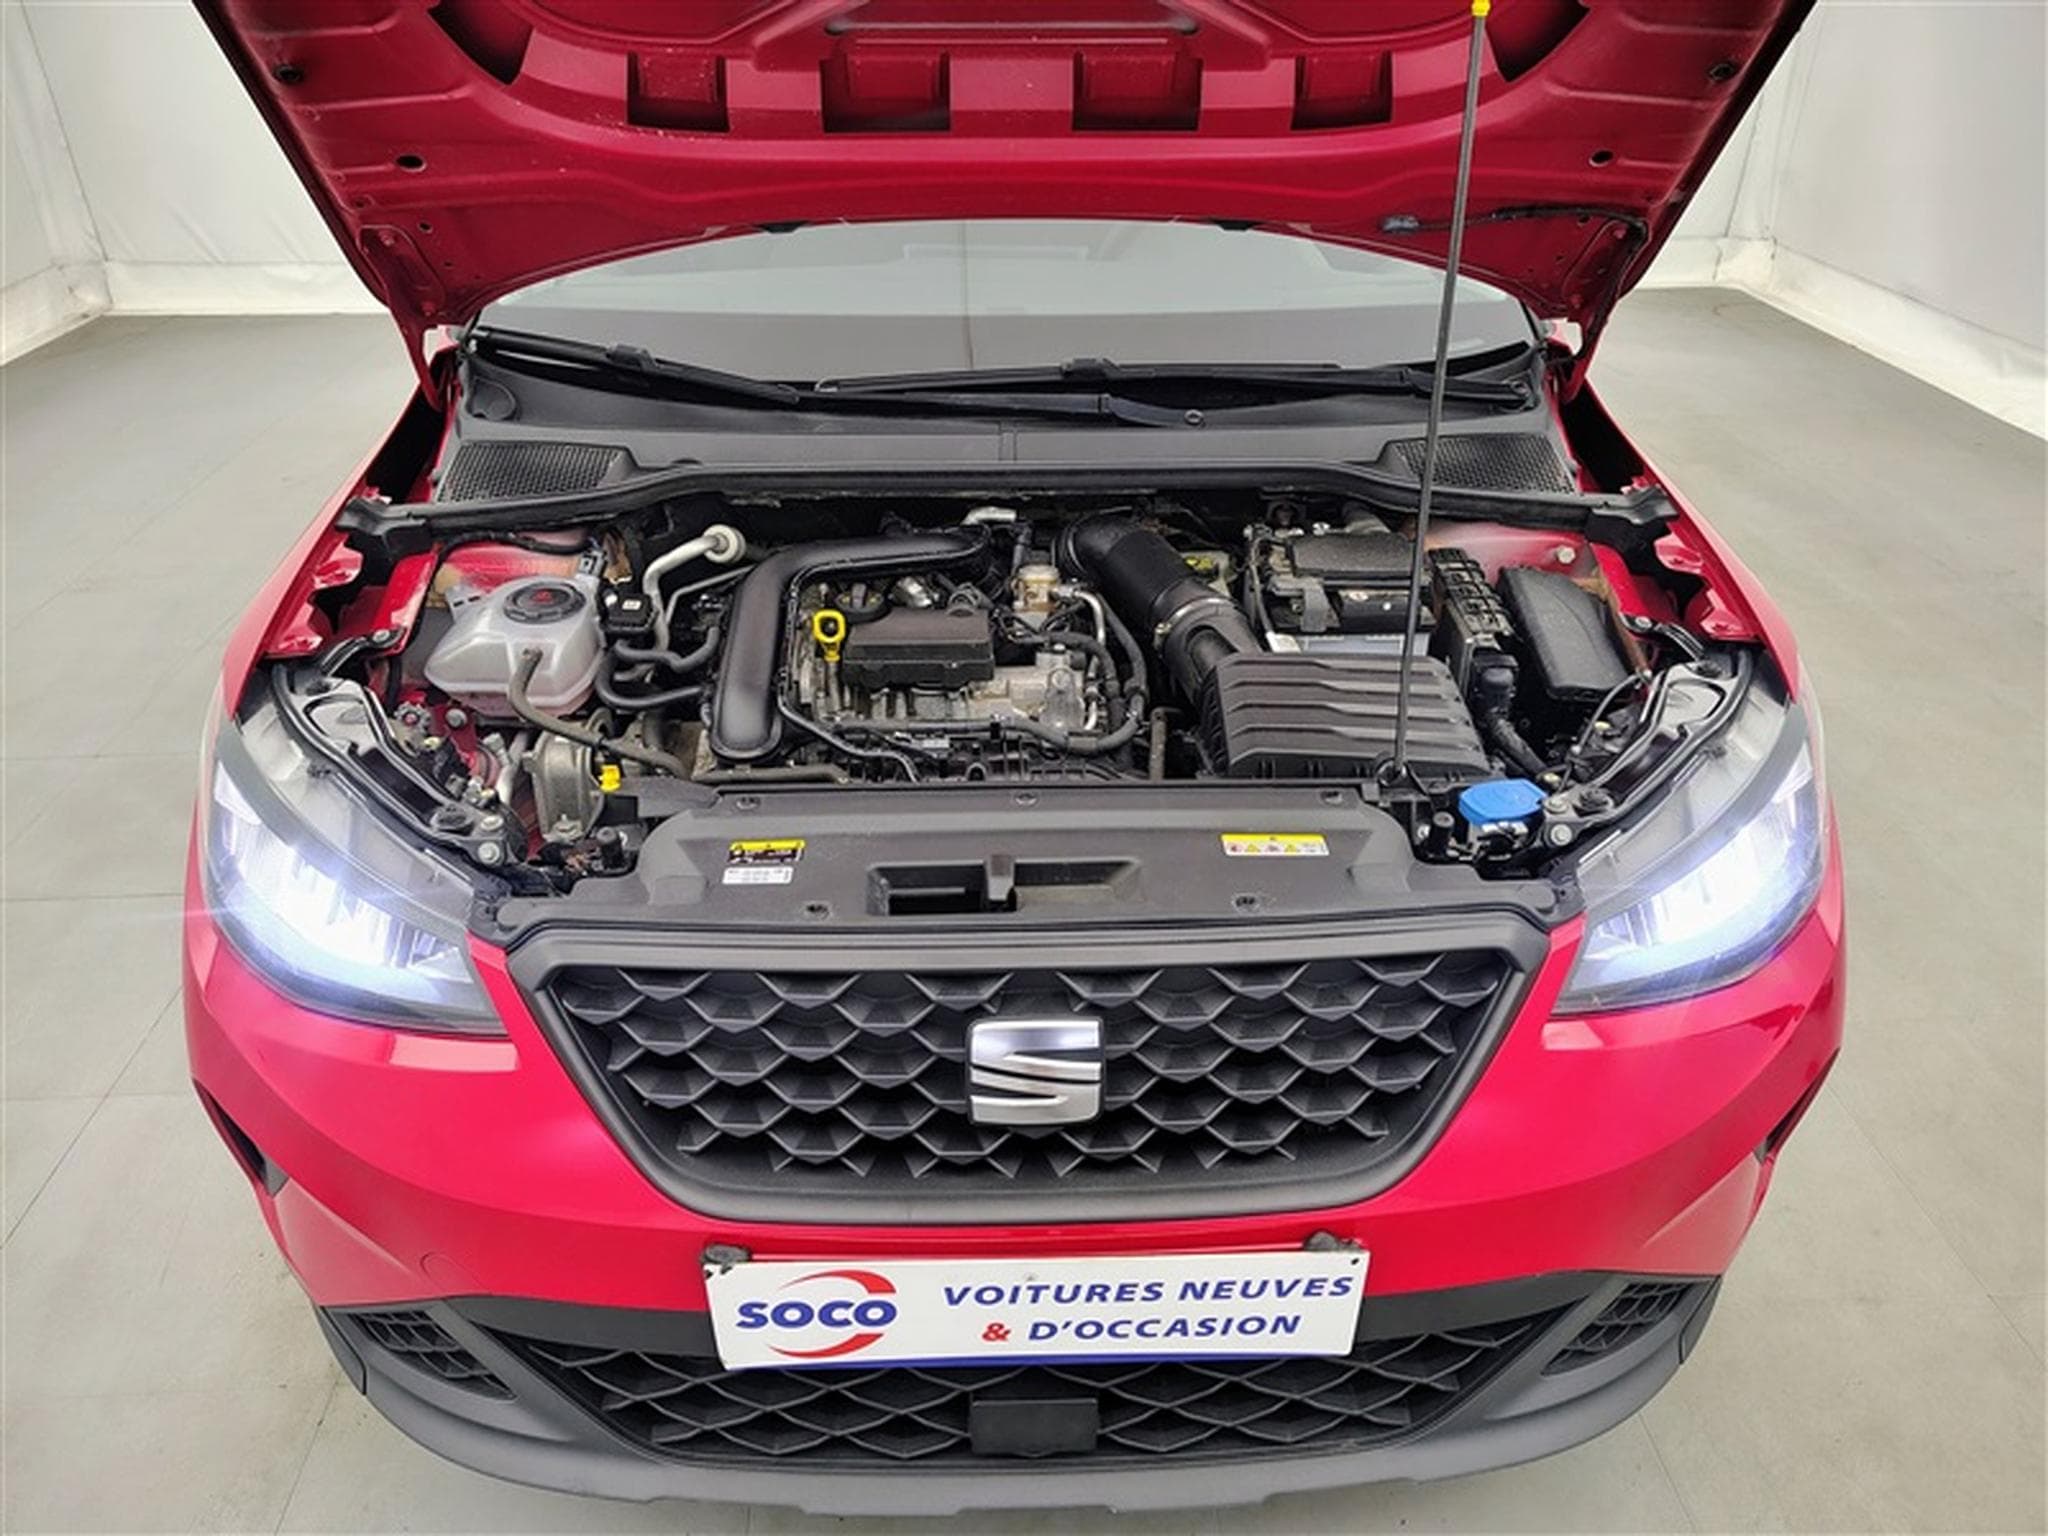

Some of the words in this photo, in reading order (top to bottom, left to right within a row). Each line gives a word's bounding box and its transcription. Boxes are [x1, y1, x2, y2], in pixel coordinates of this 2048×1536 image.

[944, 1281, 1164, 1307] VOITURES
[1179, 1276, 1354, 1301] NEUVES
[736, 1299, 897, 1329] SOCO
[982, 1323, 1009, 1342] &
